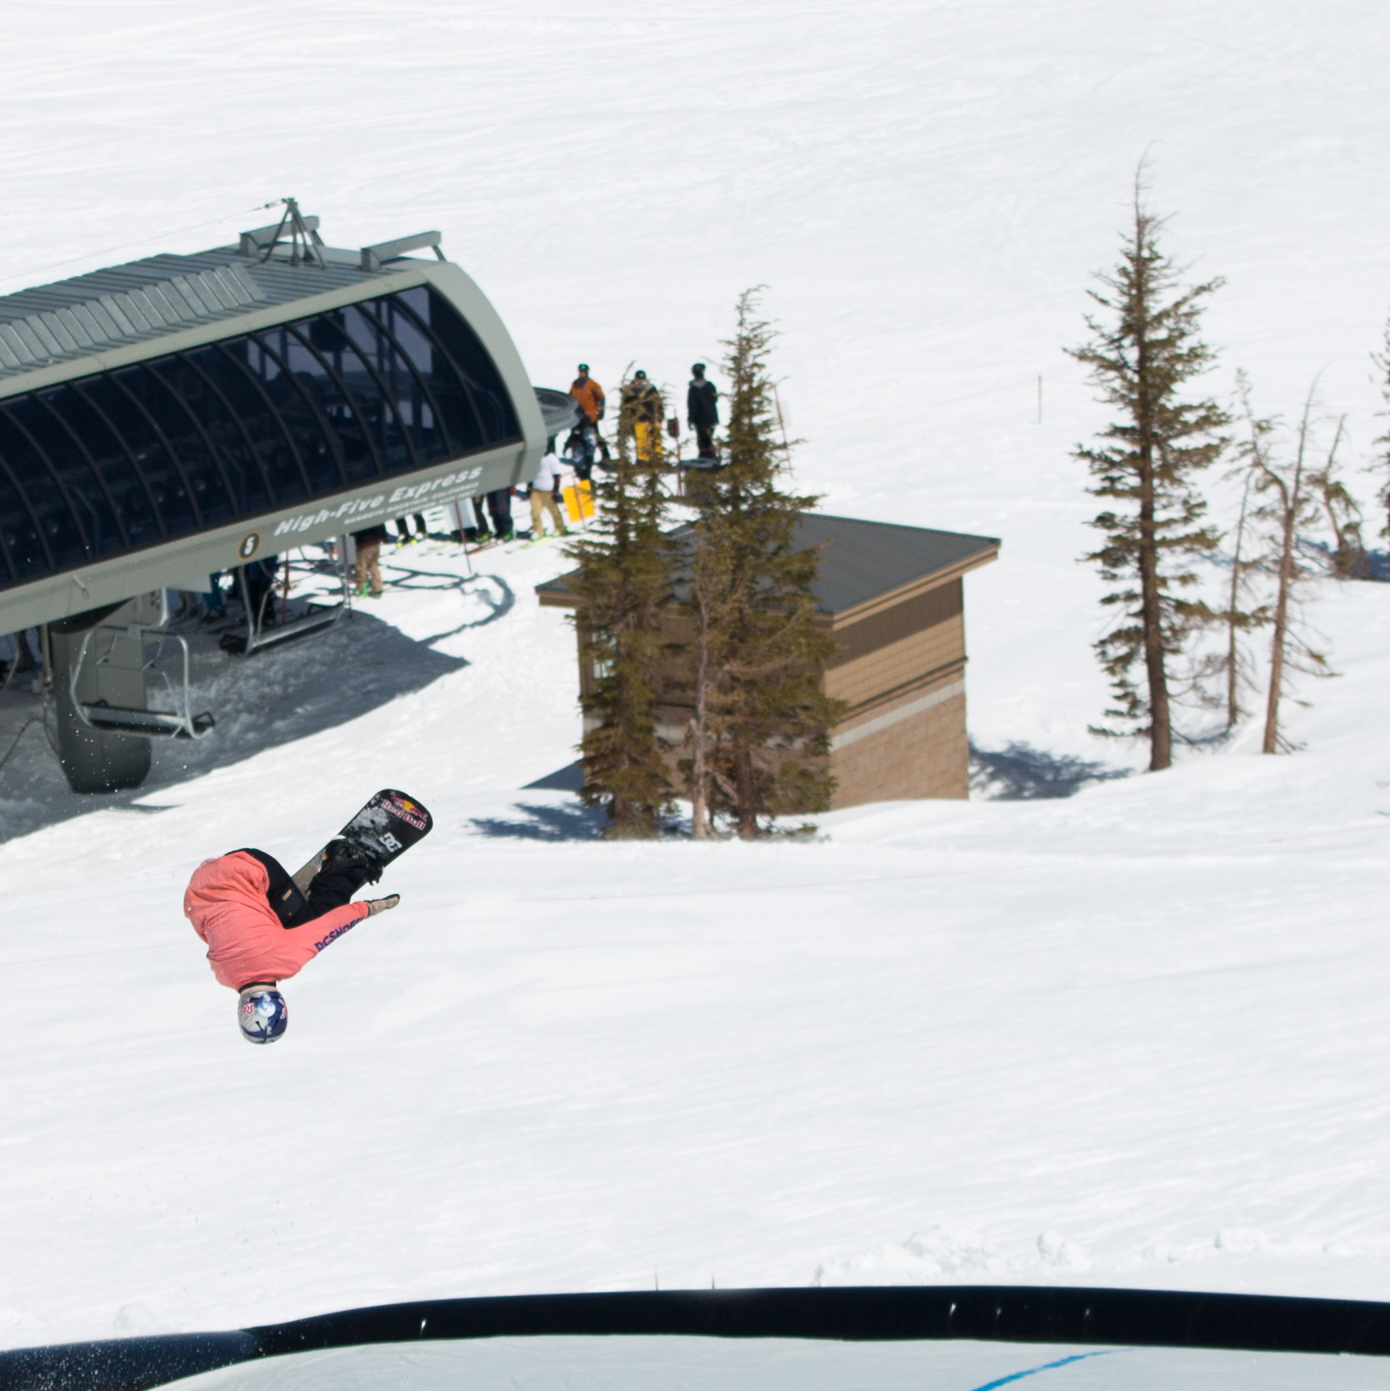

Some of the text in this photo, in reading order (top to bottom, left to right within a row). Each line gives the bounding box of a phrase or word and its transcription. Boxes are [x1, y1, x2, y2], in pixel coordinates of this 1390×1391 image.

[273, 466, 483, 536] High-Five Express
[244, 536, 255, 555] 5
